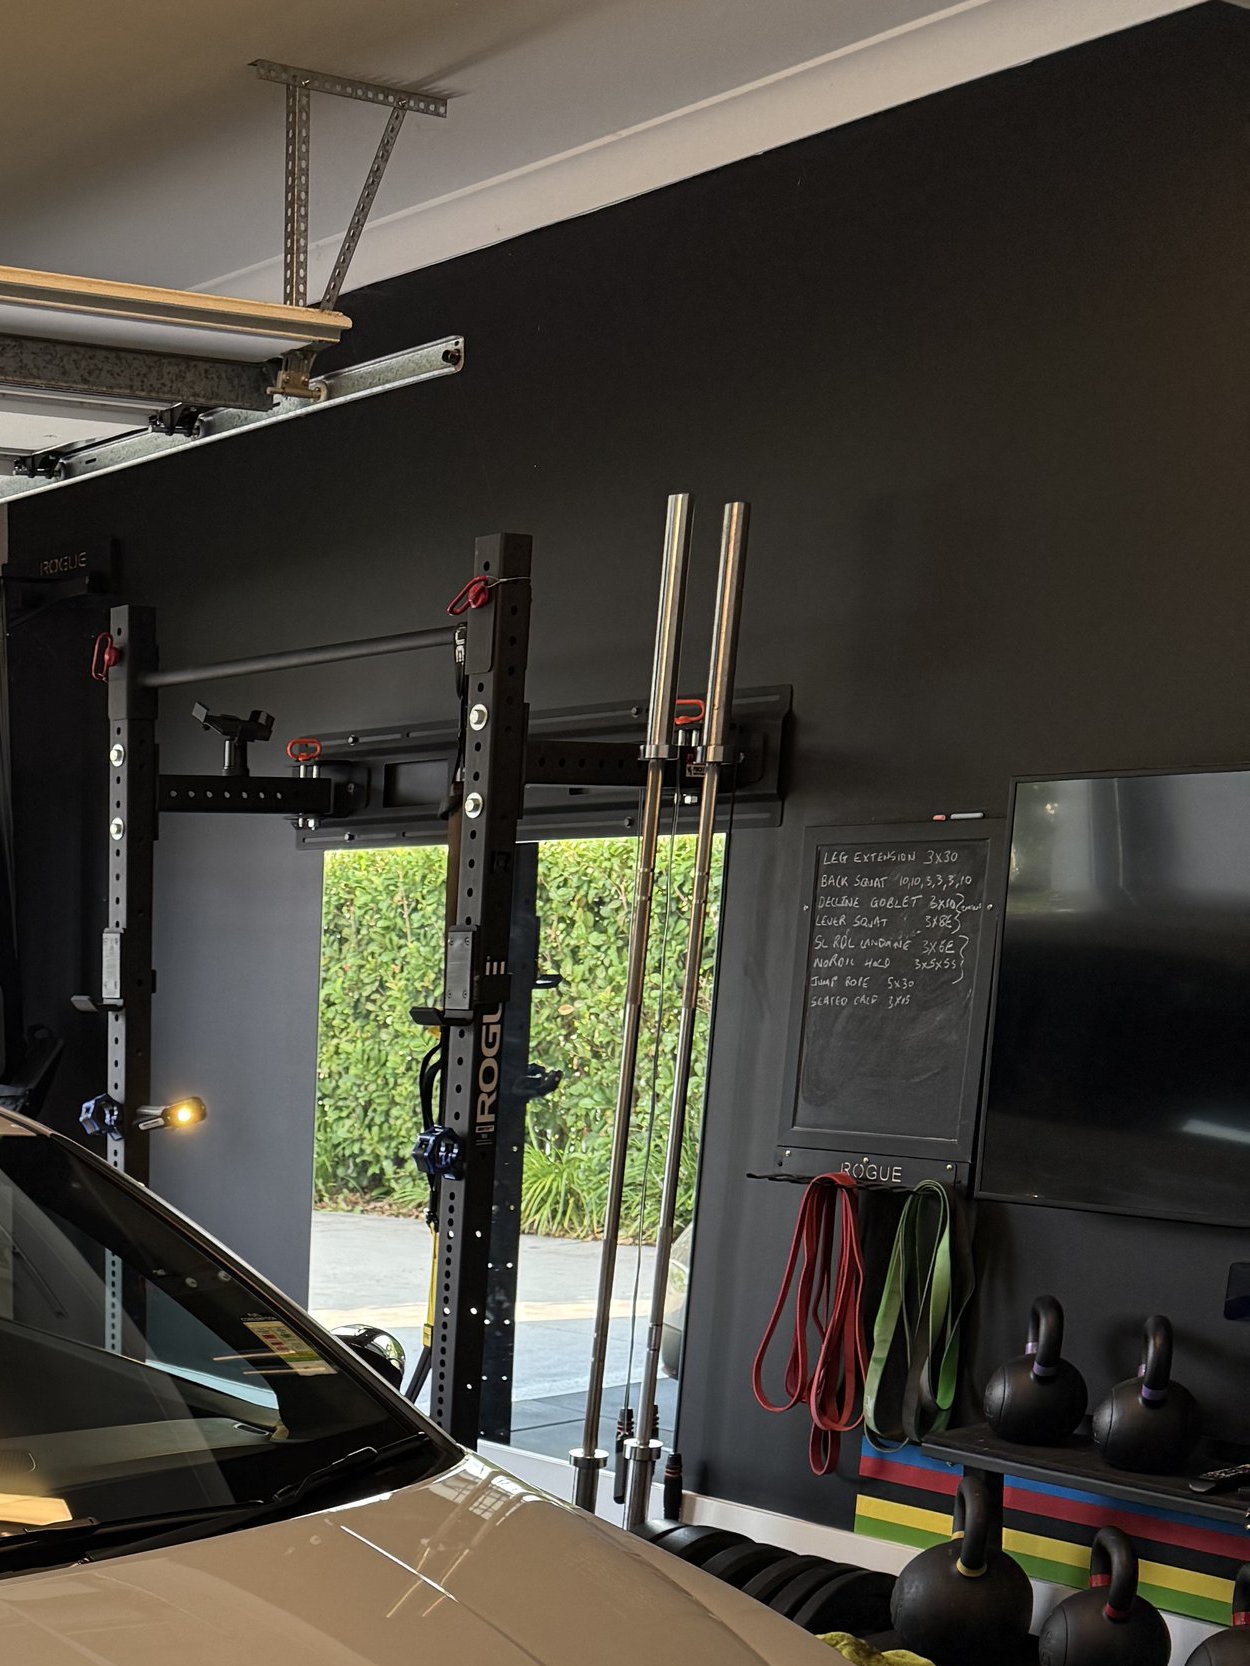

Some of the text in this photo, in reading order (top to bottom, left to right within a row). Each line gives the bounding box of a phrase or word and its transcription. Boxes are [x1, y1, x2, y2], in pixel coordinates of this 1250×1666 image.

[38, 551, 87, 576] ROGUE
[823, 851, 849, 865] LEG
[853, 850, 916, 864] EXTENSION
[820, 874, 849, 888] BACK
[853, 874, 889, 889] SQUAT
[870, 895, 923, 909] GOBLET
[815, 914, 847, 927] LEVER
[852, 914, 889, 928] SQUAT
[810, 975, 838, 987] JUMP
[475, 960, 507, 1133] ROGUE
[840, 1161, 903, 1183] ROGUE
